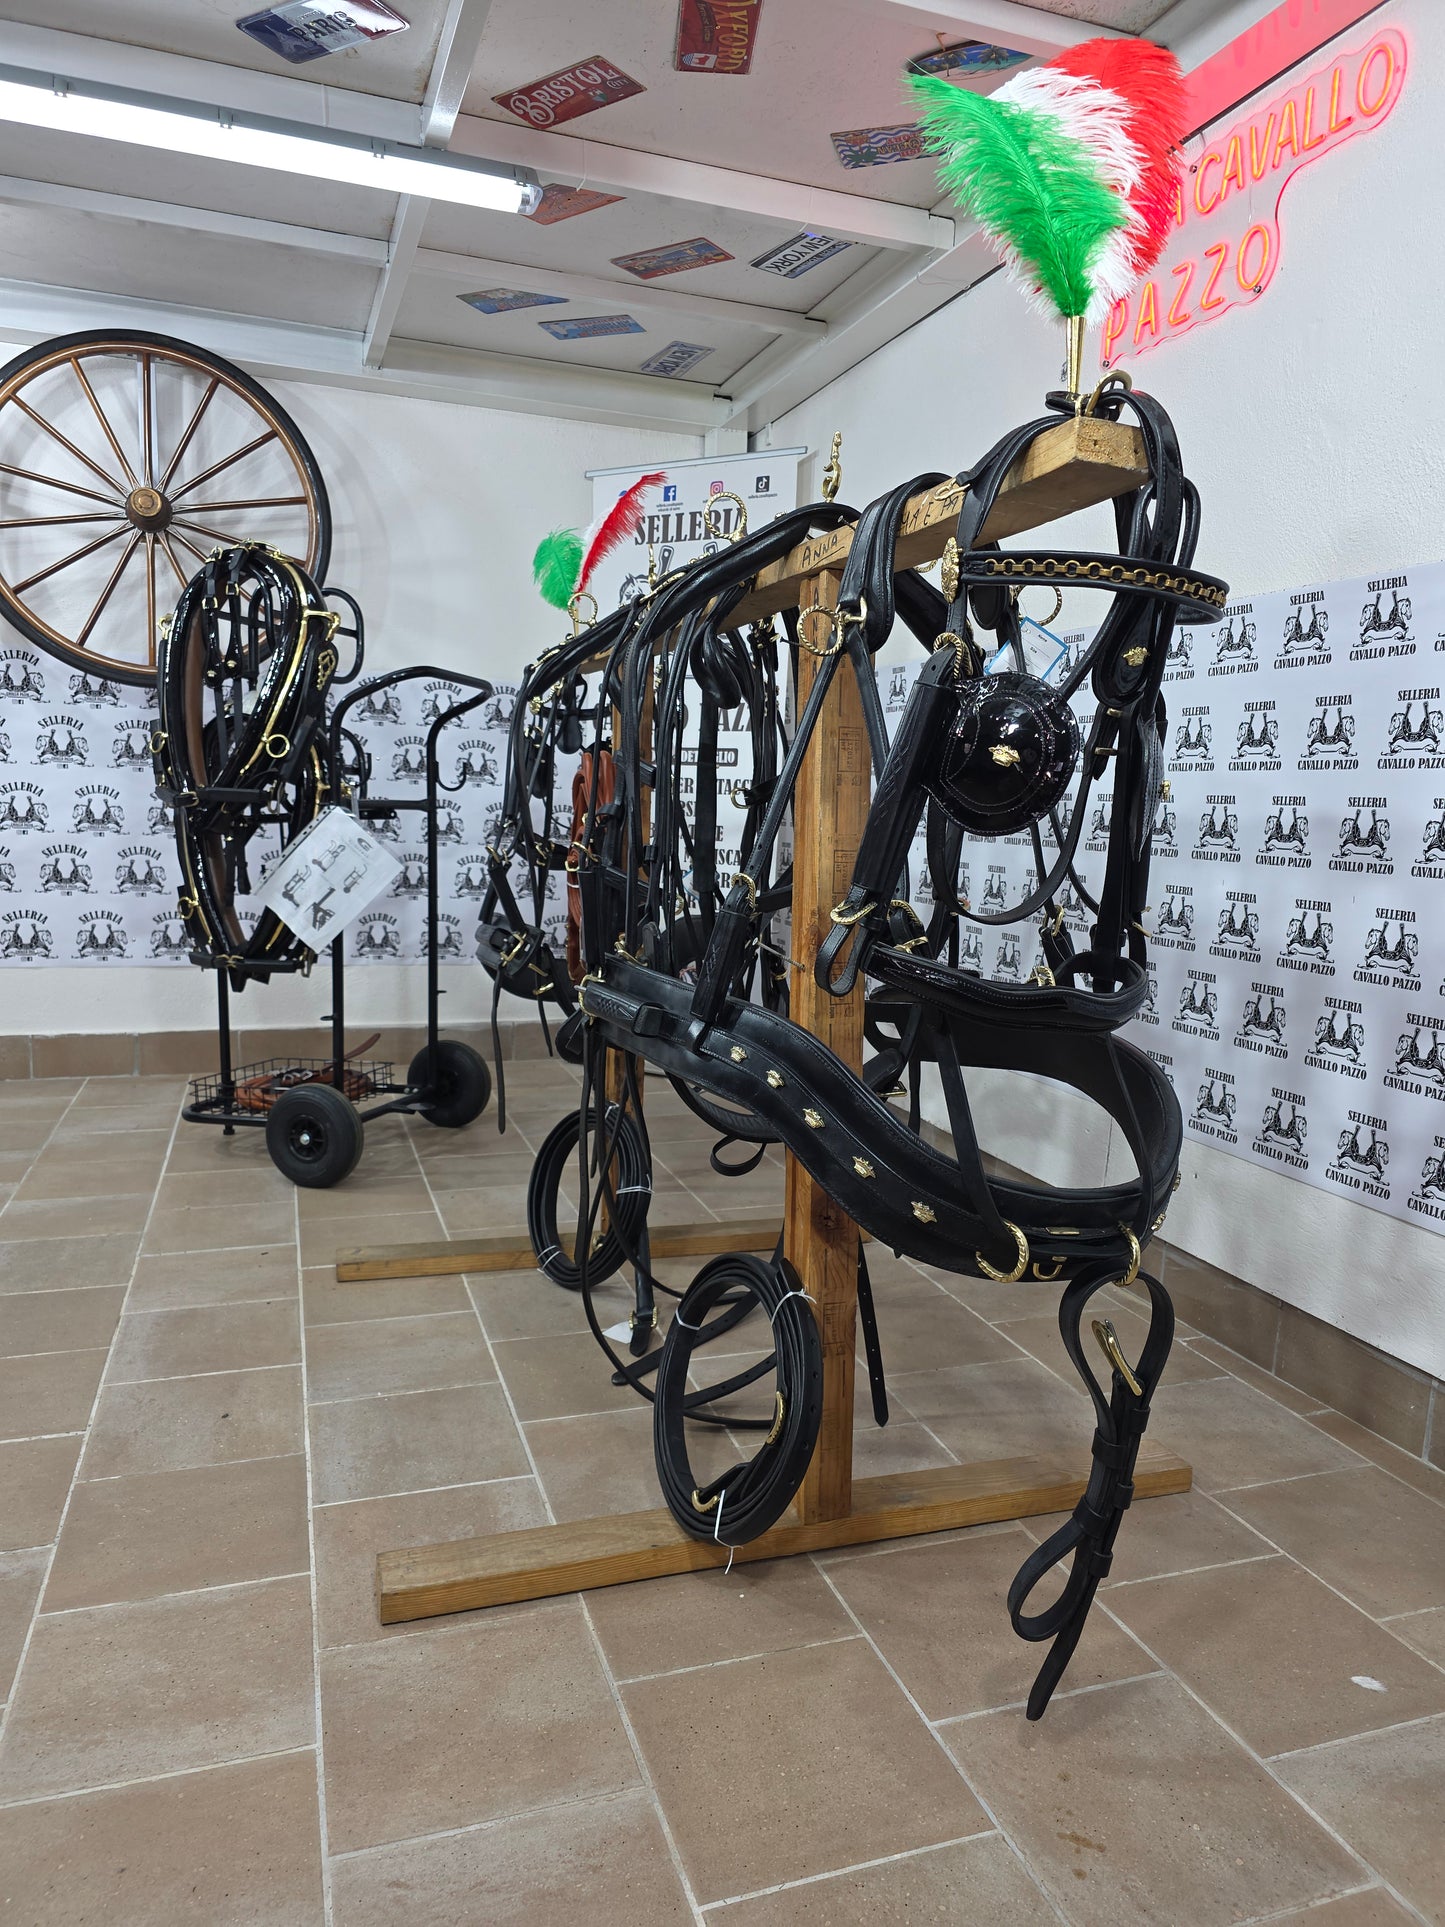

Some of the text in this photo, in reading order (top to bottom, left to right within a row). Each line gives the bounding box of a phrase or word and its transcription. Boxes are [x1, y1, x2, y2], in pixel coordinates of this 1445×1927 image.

[288, 11, 356, 43] PARIS
[510, 64, 620, 125] BRISTOL
[1195, 44, 1394, 214] CAVALLO
[765, 249, 811, 272] YORK
[1105, 225, 1270, 359] PAZZO
[802, 536, 838, 566] ANNA
[1368, 576, 1407, 592] SELLERIA
[1290, 591, 1324, 606] SELLERIA
[1350, 644, 1416, 661] CAVALLO PAZZO
[1208, 662, 1258, 676] CAVALLO PAZZO
[1274, 654, 1332, 669] CAVALLO PAZZO
[1175, 670, 1195, 680] PAZZO
[424, 681, 462, 696] SELLERIA
[1398, 688, 1440, 701] SELLERIA
[1244, 701, 1276, 712] SELLERIA
[1315, 695, 1352, 707] SELLERIA
[1182, 706, 1210, 716] SELLERIA
[38, 715, 84, 731] SELLERIA
[458, 739, 496, 754] SELLERIA
[1168, 762, 1214, 772] CAVALLO PAZZO
[1228, 761, 1281, 771] CAVALLO PAZZO
[1298, 759, 1359, 771] CAVALLO PAZZO
[1377, 759, 1415, 769] CAVALLO
[75, 785, 120, 800] SELLERIA
[1206, 795, 1236, 804] SELLERIA
[1272, 796, 1306, 806] SELLERIA
[1348, 797, 1387, 808] SELLERIA
[41, 844, 88, 860] SELLERIA
[117, 846, 162, 862] SELLERIA
[1160, 848, 1178, 858] PAZZO
[1192, 850, 1241, 863] CAVALLO PAZZO
[1256, 854, 1311, 868] CAVALLO PAZZO
[1329, 860, 1394, 875] CAVALLO PAZZO
[1165, 885, 1193, 896] SELLERIA
[1226, 892, 1257, 904] SELLERIA
[1295, 899, 1332, 912] SELLERIA
[1, 909, 49, 925] SELLERIA
[78, 909, 124, 925] SELLERIA
[358, 913, 398, 927] SELLERIA
[1376, 908, 1416, 923] SELLERIA
[1150, 936, 1196, 952] CAVALLO PAZZO
[1209, 946, 1261, 964] CAVALLO PAZZO
[1277, 957, 1336, 977] CAVALLO PAZZO
[1188, 969, 1216, 984] SELLERIA
[1353, 971, 1421, 992] CAVALLO PAZZO
[1251, 982, 1284, 998] SELLERIA
[1324, 996, 1362, 1013] SELLERIA
[1172, 1020, 1220, 1041] CAVALLO PAZZO
[1234, 1036, 1288, 1059] CAVALLO PAZZO
[1305, 1055, 1367, 1081] CAVALLO PAZZO
[1205, 1068, 1235, 1085] SELLERIA
[1384, 1075, 1421, 1095] CAVALLO
[1271, 1087, 1306, 1106] SELLERIA
[1348, 1110, 1388, 1131] SELLERIA
[1188, 1119, 1238, 1144] CAVALLO PAZZO
[1252, 1141, 1309, 1170] CAVALLO PAZZO
[1325, 1169, 1390, 1200] CAVALLO PAZZO
